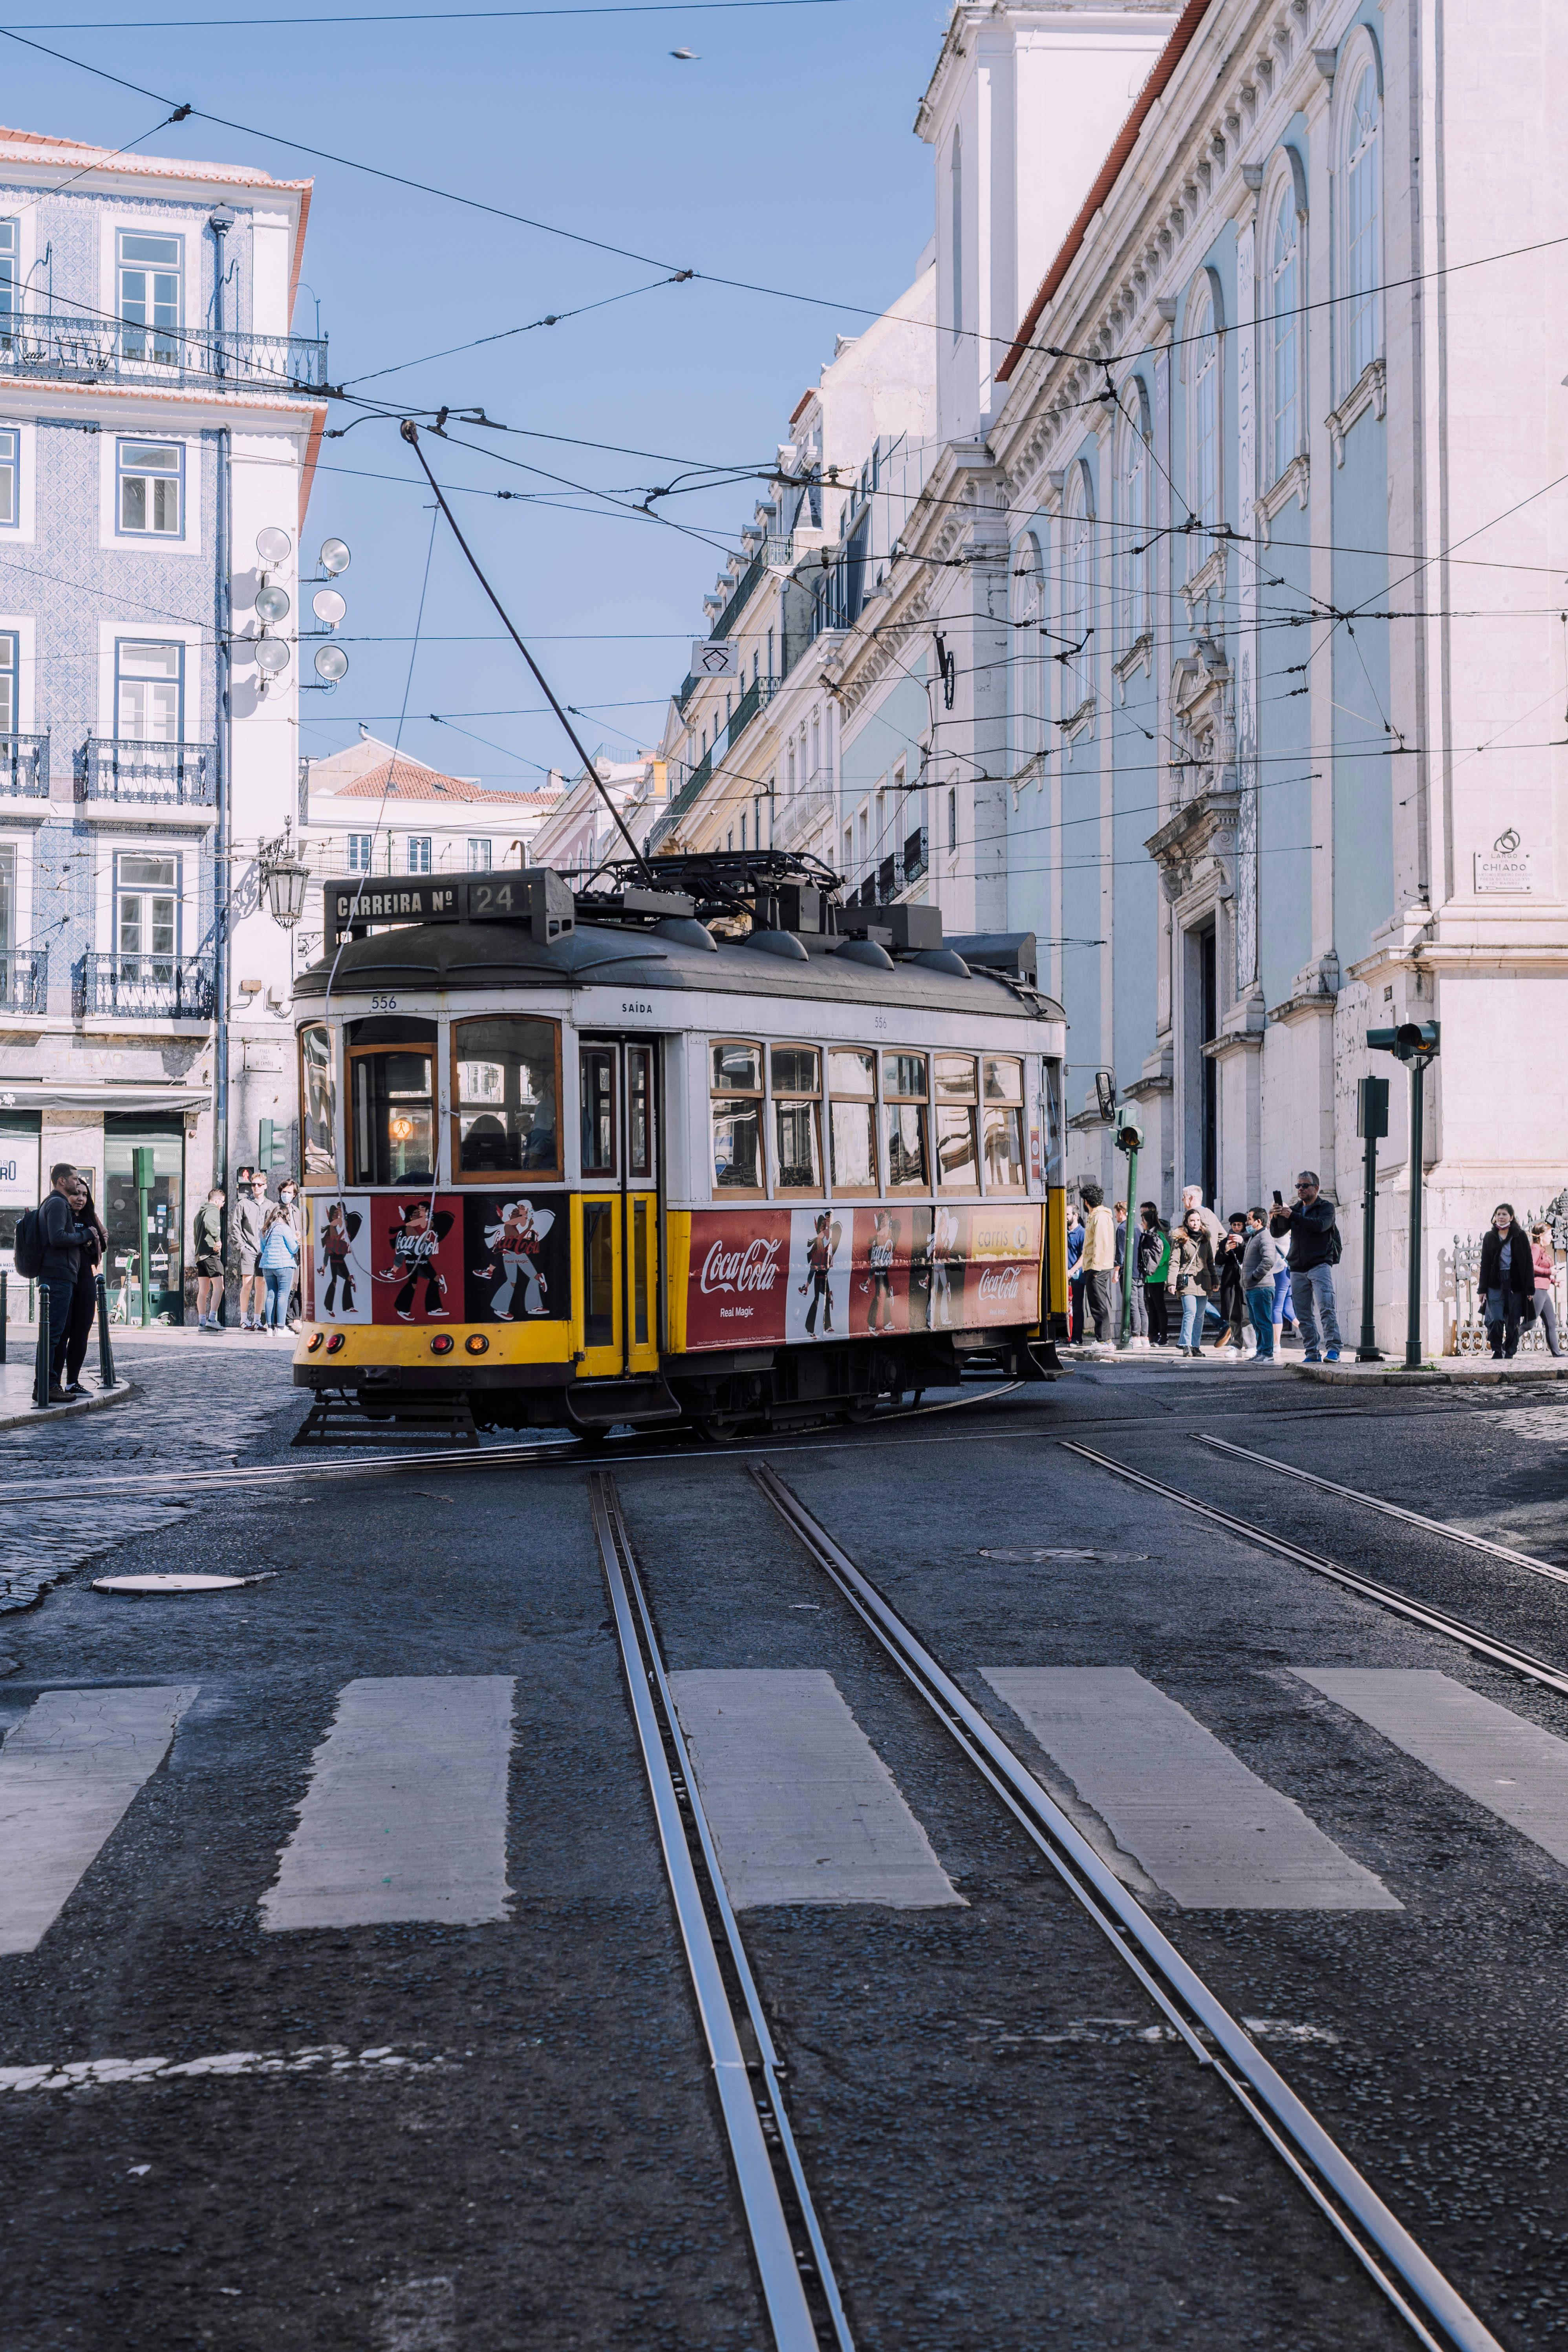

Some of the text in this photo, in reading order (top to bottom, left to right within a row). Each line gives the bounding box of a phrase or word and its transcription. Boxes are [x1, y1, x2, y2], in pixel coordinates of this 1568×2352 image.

[337, 893, 422, 917] CARREIRA
[476, 885, 514, 913] 24
[372, 996, 396, 1009] 556
[622, 1001, 652, 1013] SAÍDA
[875, 1017, 887, 1029] 556
[978, 1231, 1008, 1247] carris
[701, 1239, 783, 1294] Coca-Cola
[978, 1267, 1022, 1300] Coca-Cola
[720, 1306, 754, 1318] Real Magic
